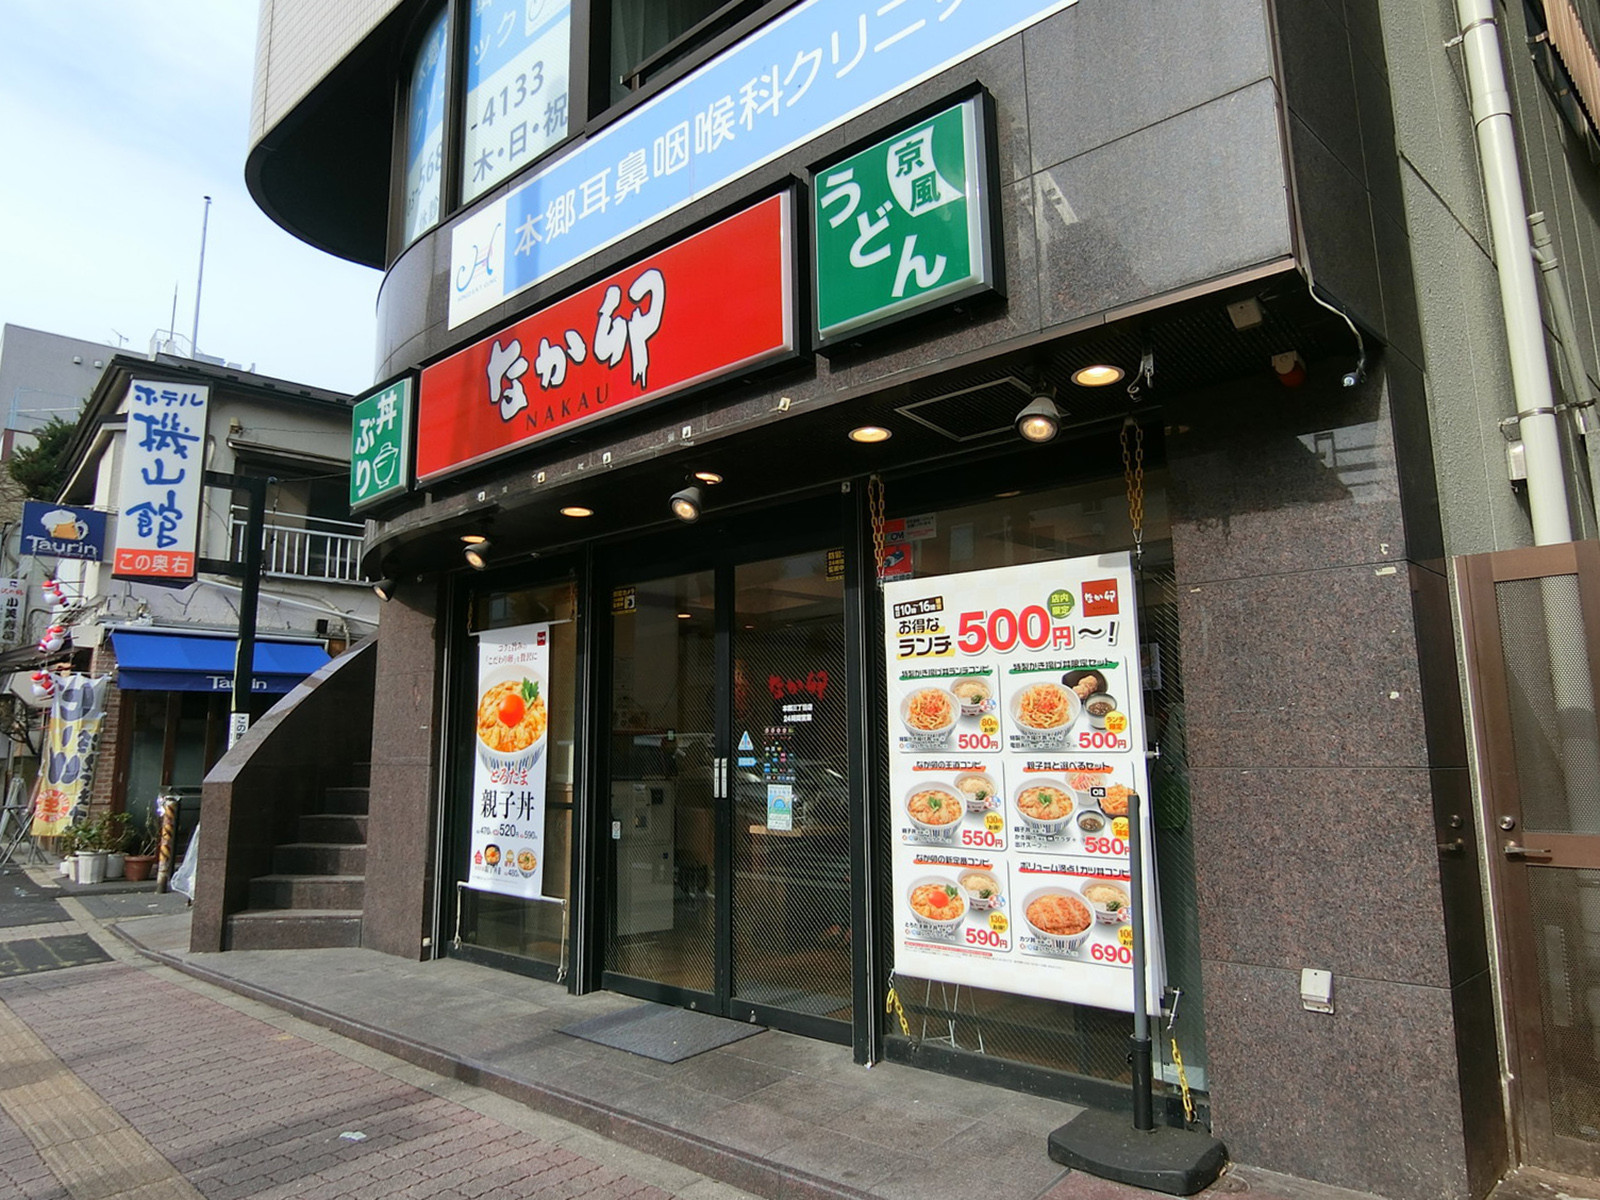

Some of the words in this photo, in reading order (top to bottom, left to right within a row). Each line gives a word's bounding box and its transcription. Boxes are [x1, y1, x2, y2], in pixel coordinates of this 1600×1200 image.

[470, 60, 545, 131] -4133
[894, 138, 942, 212] 京風
[820, 167, 948, 298] うどん
[486, 267, 667, 423] なか卯
[134, 384, 205, 406] ホテル
[525, 382, 611, 431] NAKAU
[25, 534, 98, 554] Taurin
[118, 553, 190, 574] この奥右
[1051, 593, 1069, 603] 店内
[1084, 590, 1116, 603] なか卯
[898, 617, 940, 635] お得な
[898, 635, 952, 658] ランチ
[205, 675, 268, 690] Tain
[958, 733, 999, 750] 500円
[1078, 731, 1127, 749] 500円
[489, 767, 529, 786] とろたま
[1026, 761, 1110, 771] 親子丼と選べるセット
[480, 788, 535, 822] 親子丼
[962, 829, 1004, 848] 550円
[965, 928, 1009, 949] 590円
[1090, 943, 1133, 964] 690
